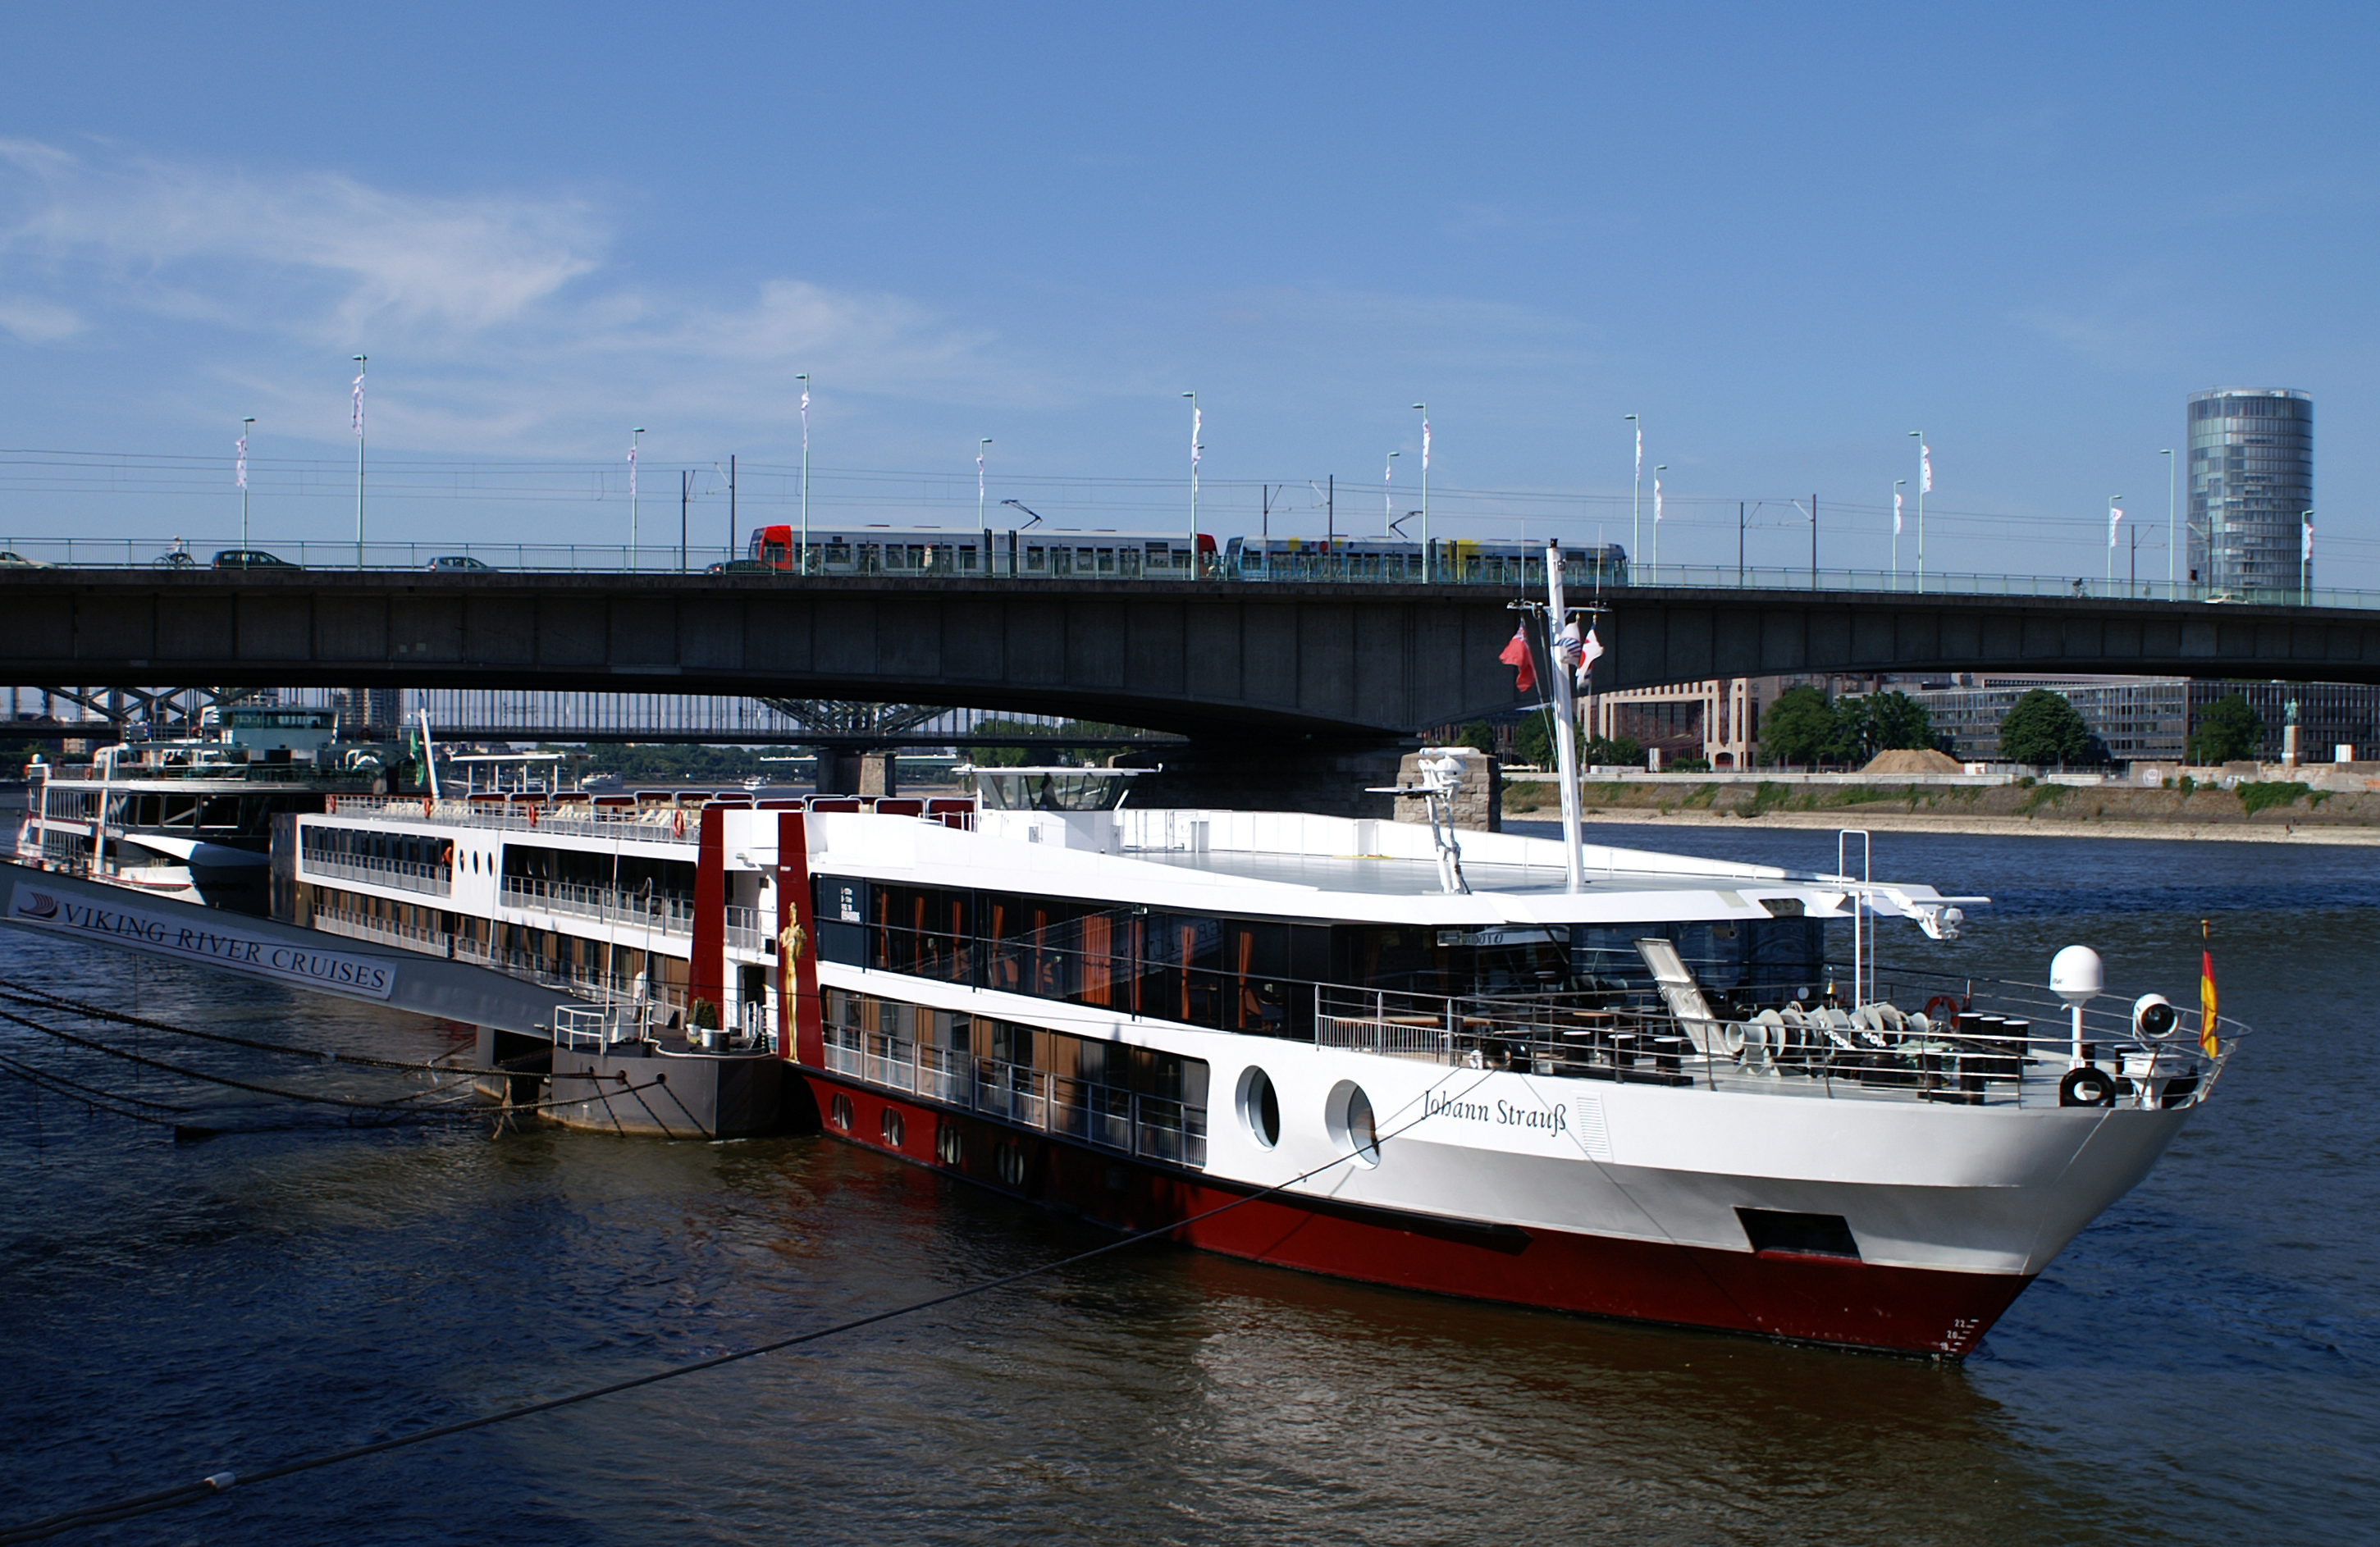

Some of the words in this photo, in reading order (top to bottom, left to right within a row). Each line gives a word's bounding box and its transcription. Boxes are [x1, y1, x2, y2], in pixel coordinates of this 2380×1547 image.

[64, 902, 166, 942] VIKING
[177, 928, 261, 963] RIVER
[272, 948, 386, 988] CRUISES
[1421, 1089, 1490, 1122] Johann
[1496, 1098, 1567, 1138] Strauß
[1947, 1330, 1958, 1339] 20
[1954, 1318, 1966, 1328] 22
